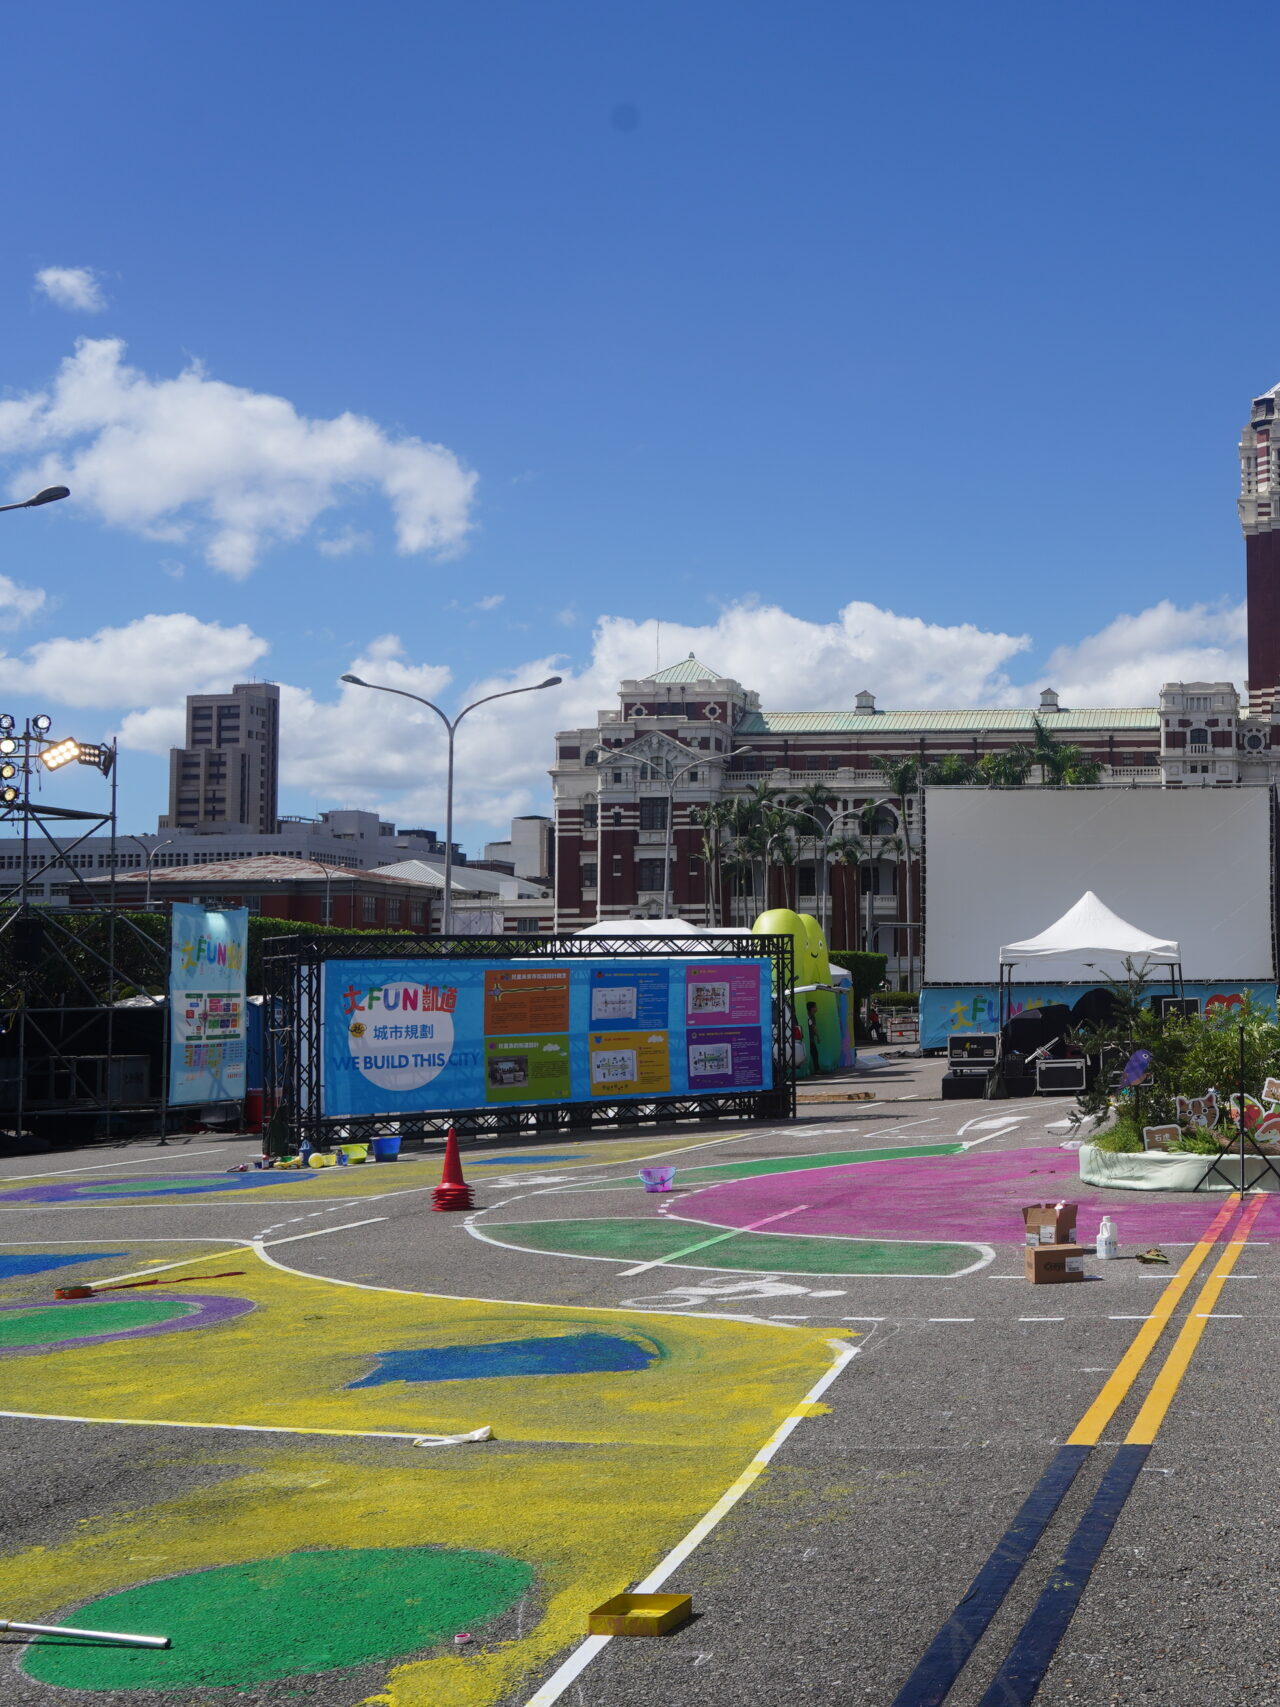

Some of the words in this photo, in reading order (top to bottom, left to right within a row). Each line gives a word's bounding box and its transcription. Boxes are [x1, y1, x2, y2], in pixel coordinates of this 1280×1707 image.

[373, 1023, 434, 1040] 城市規劃
[332, 1056, 360, 1071] WE
[363, 1054, 409, 1070] BUILD
[412, 1053, 446, 1068] THIS
[449, 1051, 481, 1067] CITY
